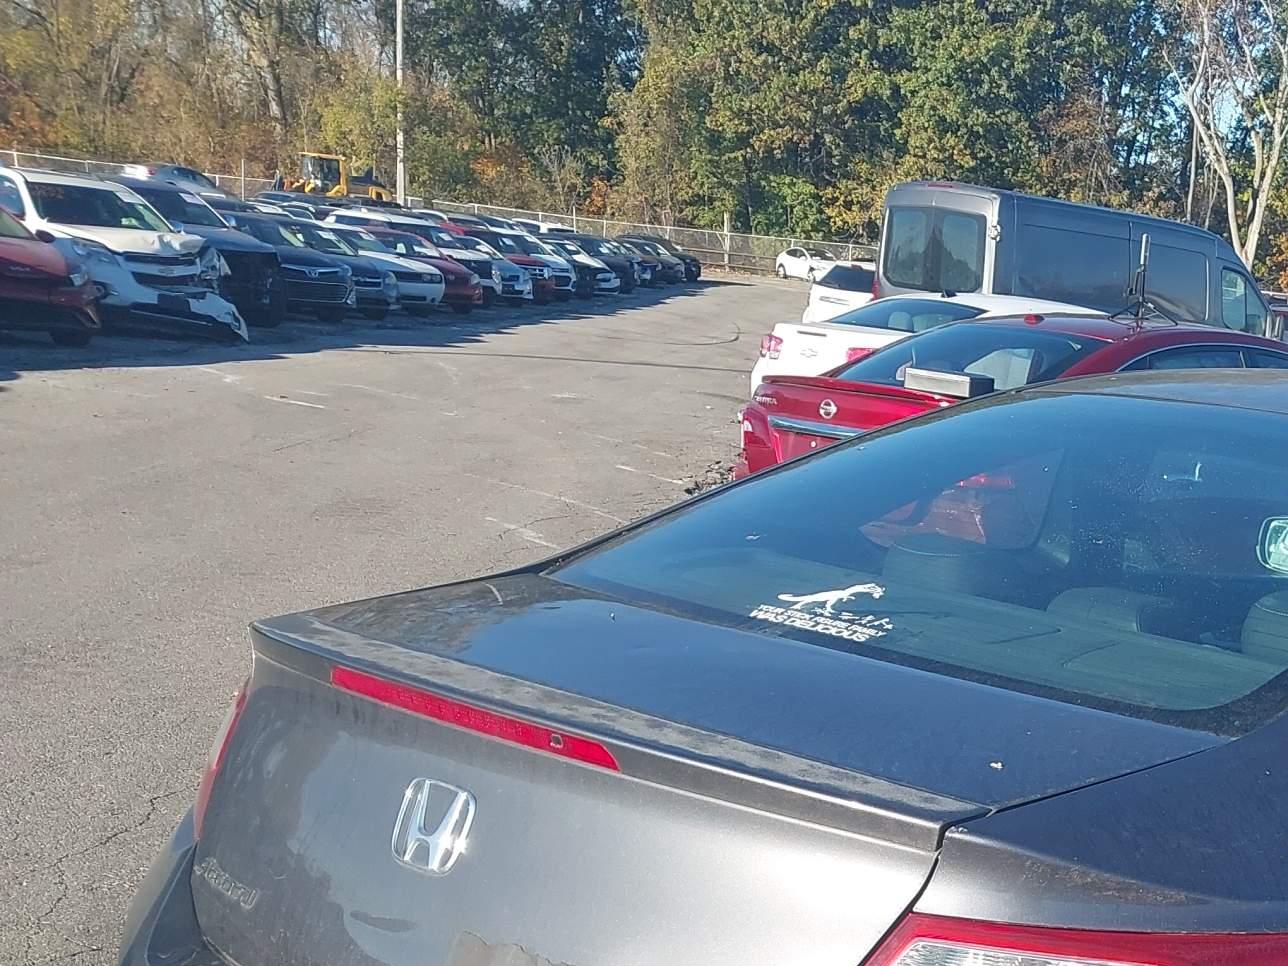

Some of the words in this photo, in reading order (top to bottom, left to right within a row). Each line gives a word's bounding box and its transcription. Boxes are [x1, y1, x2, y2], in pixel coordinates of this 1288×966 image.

[749, 609, 788, 622] WAS
[783, 617, 870, 642] DELICIOUS
[758, 604, 786, 614] YOUR
[784, 609, 815, 621] STICK
[811, 616, 852, 629] FIGURE
[848, 624, 887, 637] FAMILY
